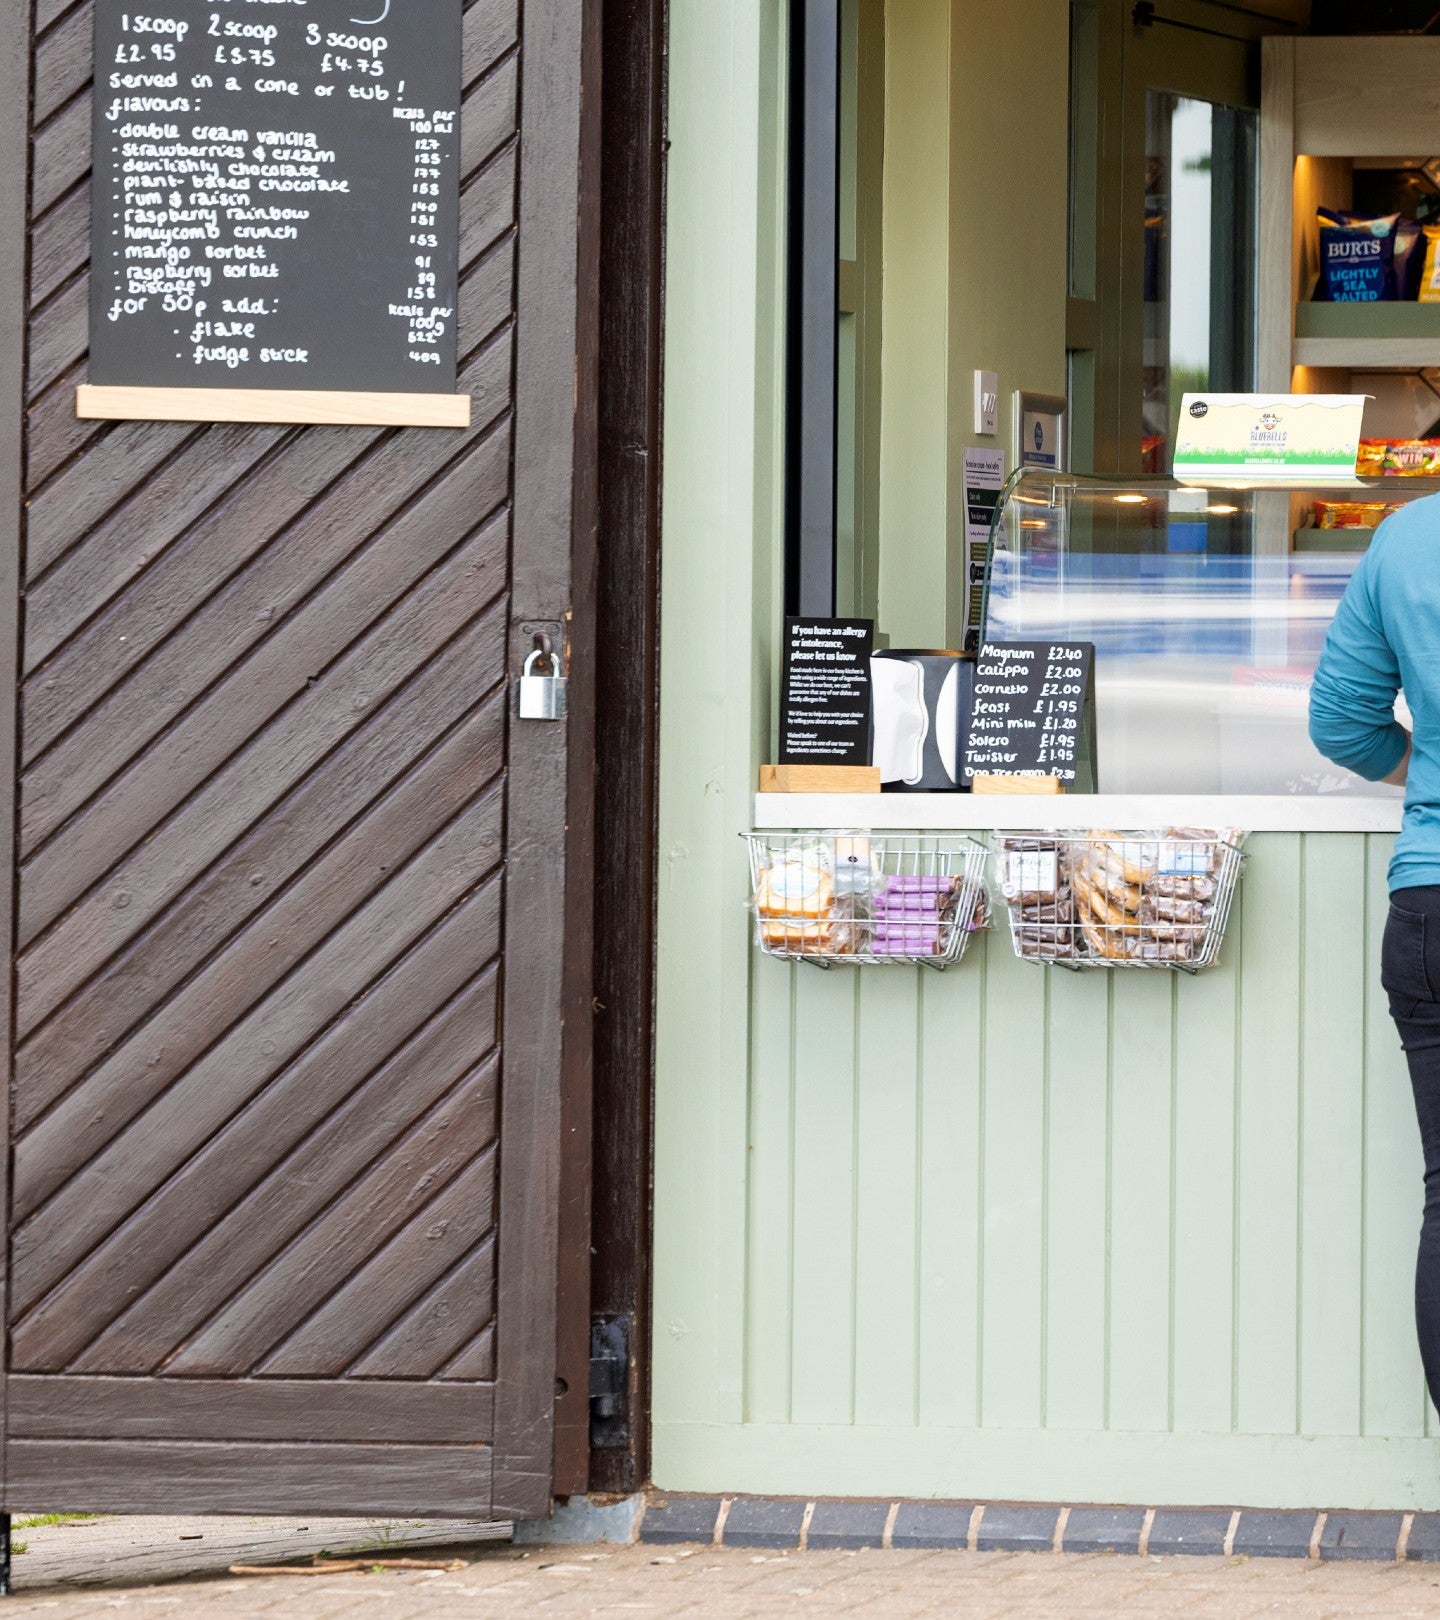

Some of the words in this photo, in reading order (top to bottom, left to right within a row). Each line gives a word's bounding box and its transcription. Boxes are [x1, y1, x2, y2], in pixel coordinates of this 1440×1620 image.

[121, 14, 129, 31] 1
[132, 15, 189, 42] scoop
[207, 13, 221, 36] 2
[223, 21, 278, 45] scoop
[305, 23, 322, 45] 3
[326, 32, 388, 58] scoop
[114, 43, 177, 63] £2.95
[321, 53, 385, 77] £4.75
[109, 72, 179, 89] served
[190, 73, 213, 88] in
[224, 77, 242, 91] a
[254, 78, 300, 96] cone
[314, 85, 336, 97] or
[432, 110, 457, 123] per
[119, 123, 180, 140] double
[191, 126, 249, 142] cream
[256, 131, 319, 149] vanilla
[415, 139, 440, 150] 127
[271, 148, 336, 163] cream
[228, 162, 321, 178] chocolate
[191, 174, 251, 191] based
[258, 178, 350, 193] chocolate
[125, 192, 162, 206] rum
[189, 190, 250, 206] raisin
[124, 208, 218, 228] raspberry
[226, 206, 310, 221] rainbow
[124, 223, 221, 247] honeycomb
[233, 225, 298, 239] crunch
[125, 245, 191, 266] mango
[204, 245, 267, 259] sorbet
[1328, 240, 1381, 257] BURTS
[126, 263, 212, 287] raspberry
[222, 263, 279, 278] sorbet
[1330, 267, 1380, 281] LIGHTLY
[128, 279, 196, 296] biscoff
[1343, 279, 1367, 291] SEA
[1333, 290, 1378, 303] SALTED
[107, 297, 148, 321] for
[431, 306, 453, 320] per
[189, 321, 255, 343] flake
[192, 345, 250, 368] fudge
[259, 348, 309, 363] stick
[799, 627, 814, 637] you
[813, 625, 832, 635] have
[832, 628, 842, 636] an
[842, 626, 867, 638] allergy
[791, 639, 801, 647] or
[790, 651, 815, 661] please
[815, 651, 826, 660] let
[835, 651, 857, 661] know
[980, 644, 1035, 667] Magnum
[1048, 646, 1082, 660] £2.40
[976, 664, 1030, 678] Calippo
[1044, 664, 1082, 679] £2.00
[1040, 683, 1081, 697] £2.00
[1033, 700, 1078, 713] £1.95
[971, 717, 1004, 729] Mini
[1042, 716, 1077, 730] £1.20
[968, 733, 1010, 747] Solero
[1039, 733, 1076, 748] £1.95
[965, 749, 1018, 763] Twister
[1036, 749, 1074, 763] £1.95
